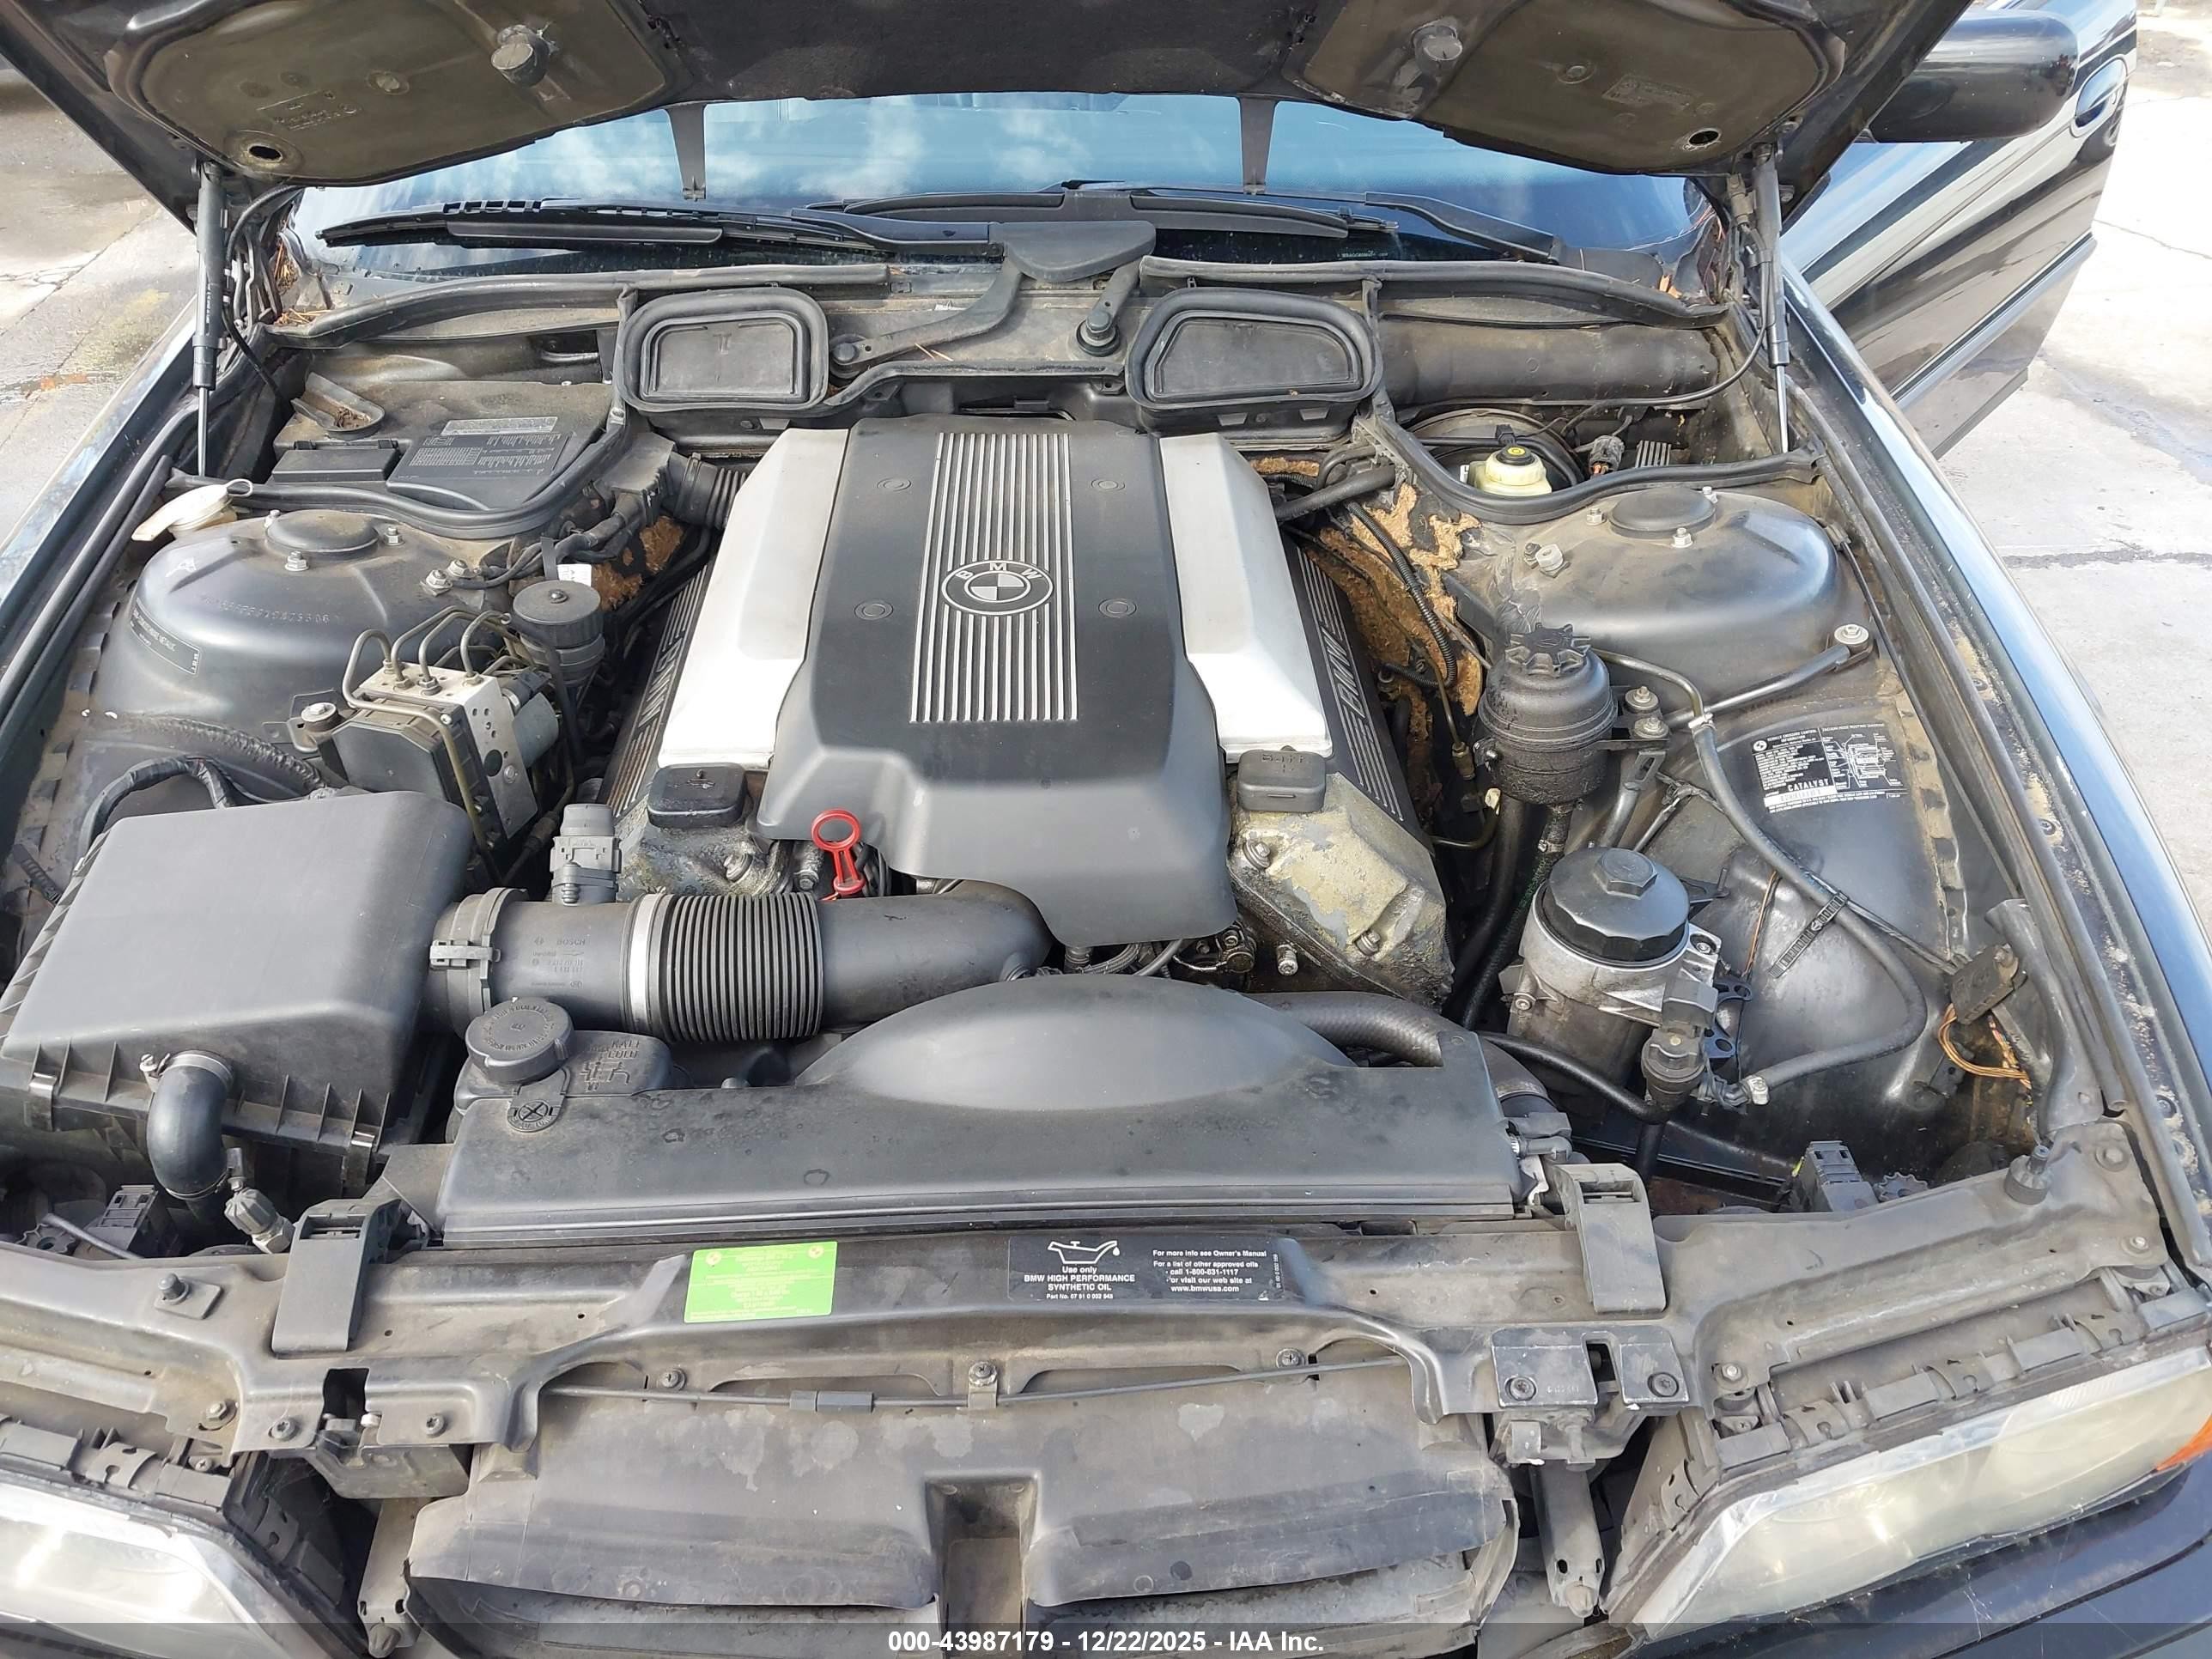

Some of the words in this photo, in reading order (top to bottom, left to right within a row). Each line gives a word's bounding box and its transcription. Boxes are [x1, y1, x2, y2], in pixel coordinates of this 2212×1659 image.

[955, 562, 1042, 580] BMW
[1321, 625, 1366, 719] BMW
[638, 637, 684, 728] BMW
[1787, 778, 1829, 792] CATALYST
[1172, 1260, 1183, 1268] list
[1212, 1261, 1244, 1269] approved
[1079, 1266, 1097, 1275] only
[1024, 1274, 1045, 1283] BMW
[1180, 1276, 1196, 1285] visit
[1212, 1276, 1228, 1285] web
[1229, 1276, 1243, 1285] site
[1244, 1276, 1253, 1285] at
[1048, 1283, 1096, 1291] SYNTHETIC
[1097, 1283, 1112, 1291] OIL
[1170, 1285, 1240, 1293] www.bmwusa.com
